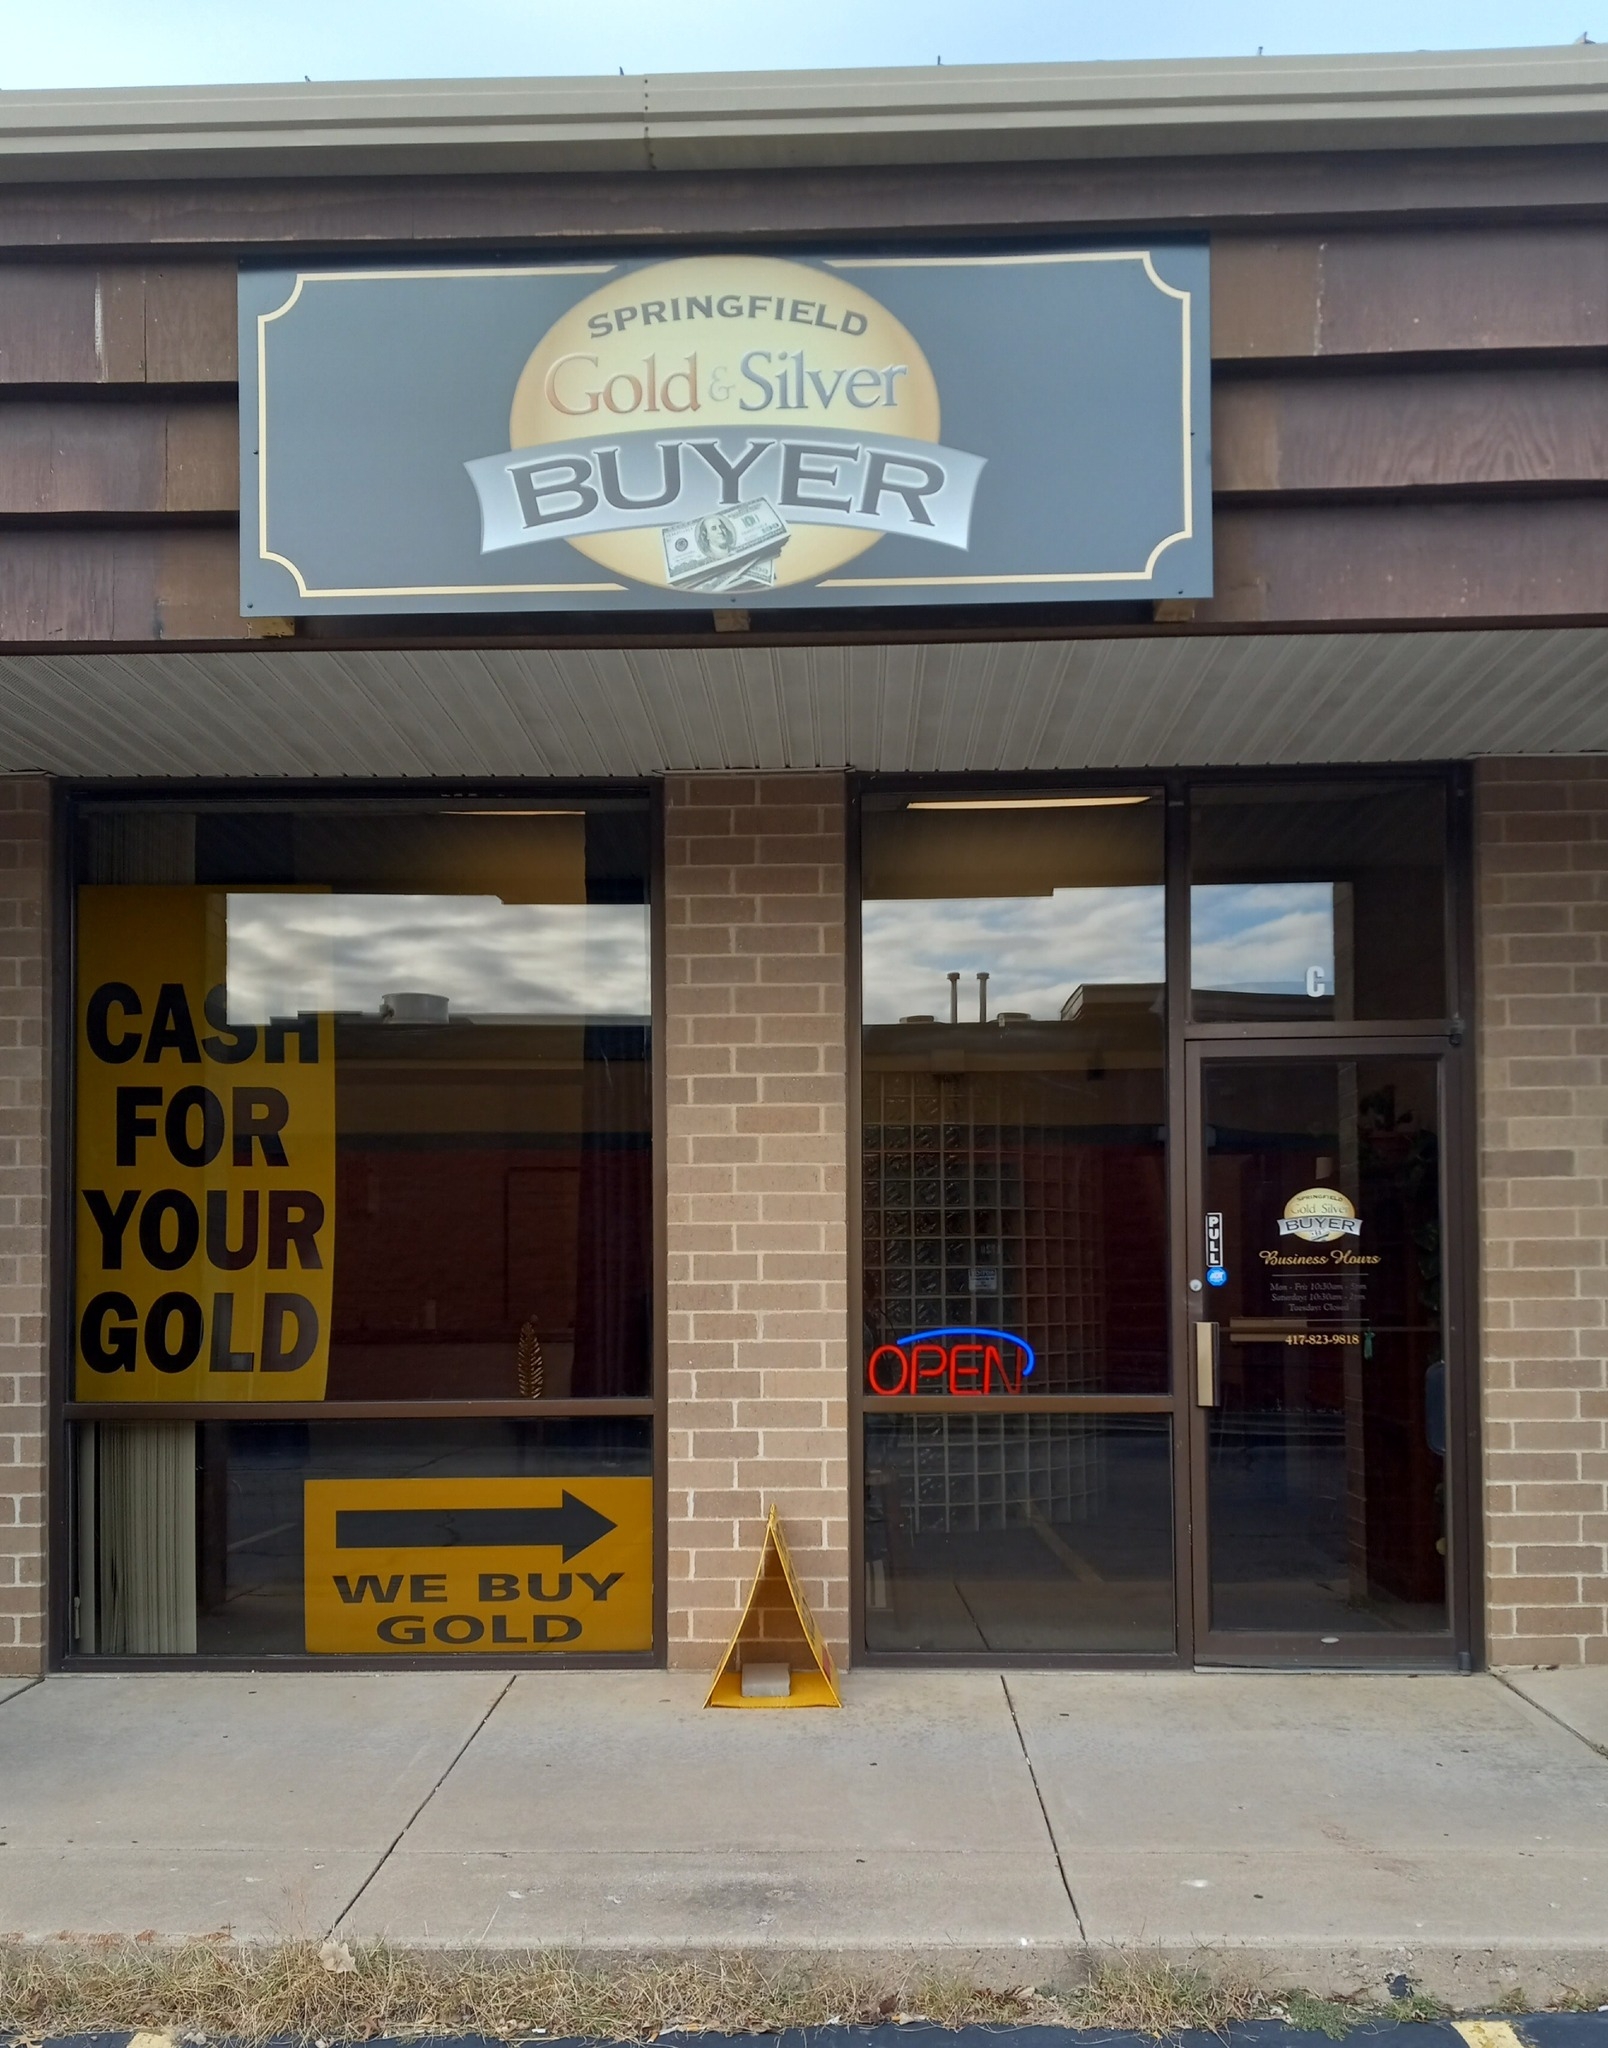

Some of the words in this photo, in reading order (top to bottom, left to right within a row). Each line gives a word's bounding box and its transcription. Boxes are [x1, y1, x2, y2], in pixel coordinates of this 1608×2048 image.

[588, 294, 868, 338] SPRINGFIELD
[544, 351, 701, 415] Gold
[708, 366, 736, 402] &
[739, 350, 908, 411] Silver
[507, 438, 945, 529] BUYER
[1306, 965, 1325, 997] C
[86, 982, 319, 1065] CASH
[116, 1085, 290, 1168] FOR
[1296, 1194, 1343, 1202] SPRINGFIELD
[82, 1189, 325, 1271] YOUR
[1208, 1216, 1219, 1264] PULL
[1285, 1217, 1355, 1231] BUYER
[1258, 1249, 1329, 1265] Business
[1330, 1249, 1381, 1265] Hours
[1270, 1283, 1288, 1291] Mon
[80, 1291, 319, 1373] GOLD
[1285, 1335, 1360, 1346] 417-823-9818
[868, 1344, 1023, 1396] OPEN
[332, 1574, 447, 1604] WE
[479, 1572, 625, 1602] BUY
[377, 1614, 583, 1645] GOLD
